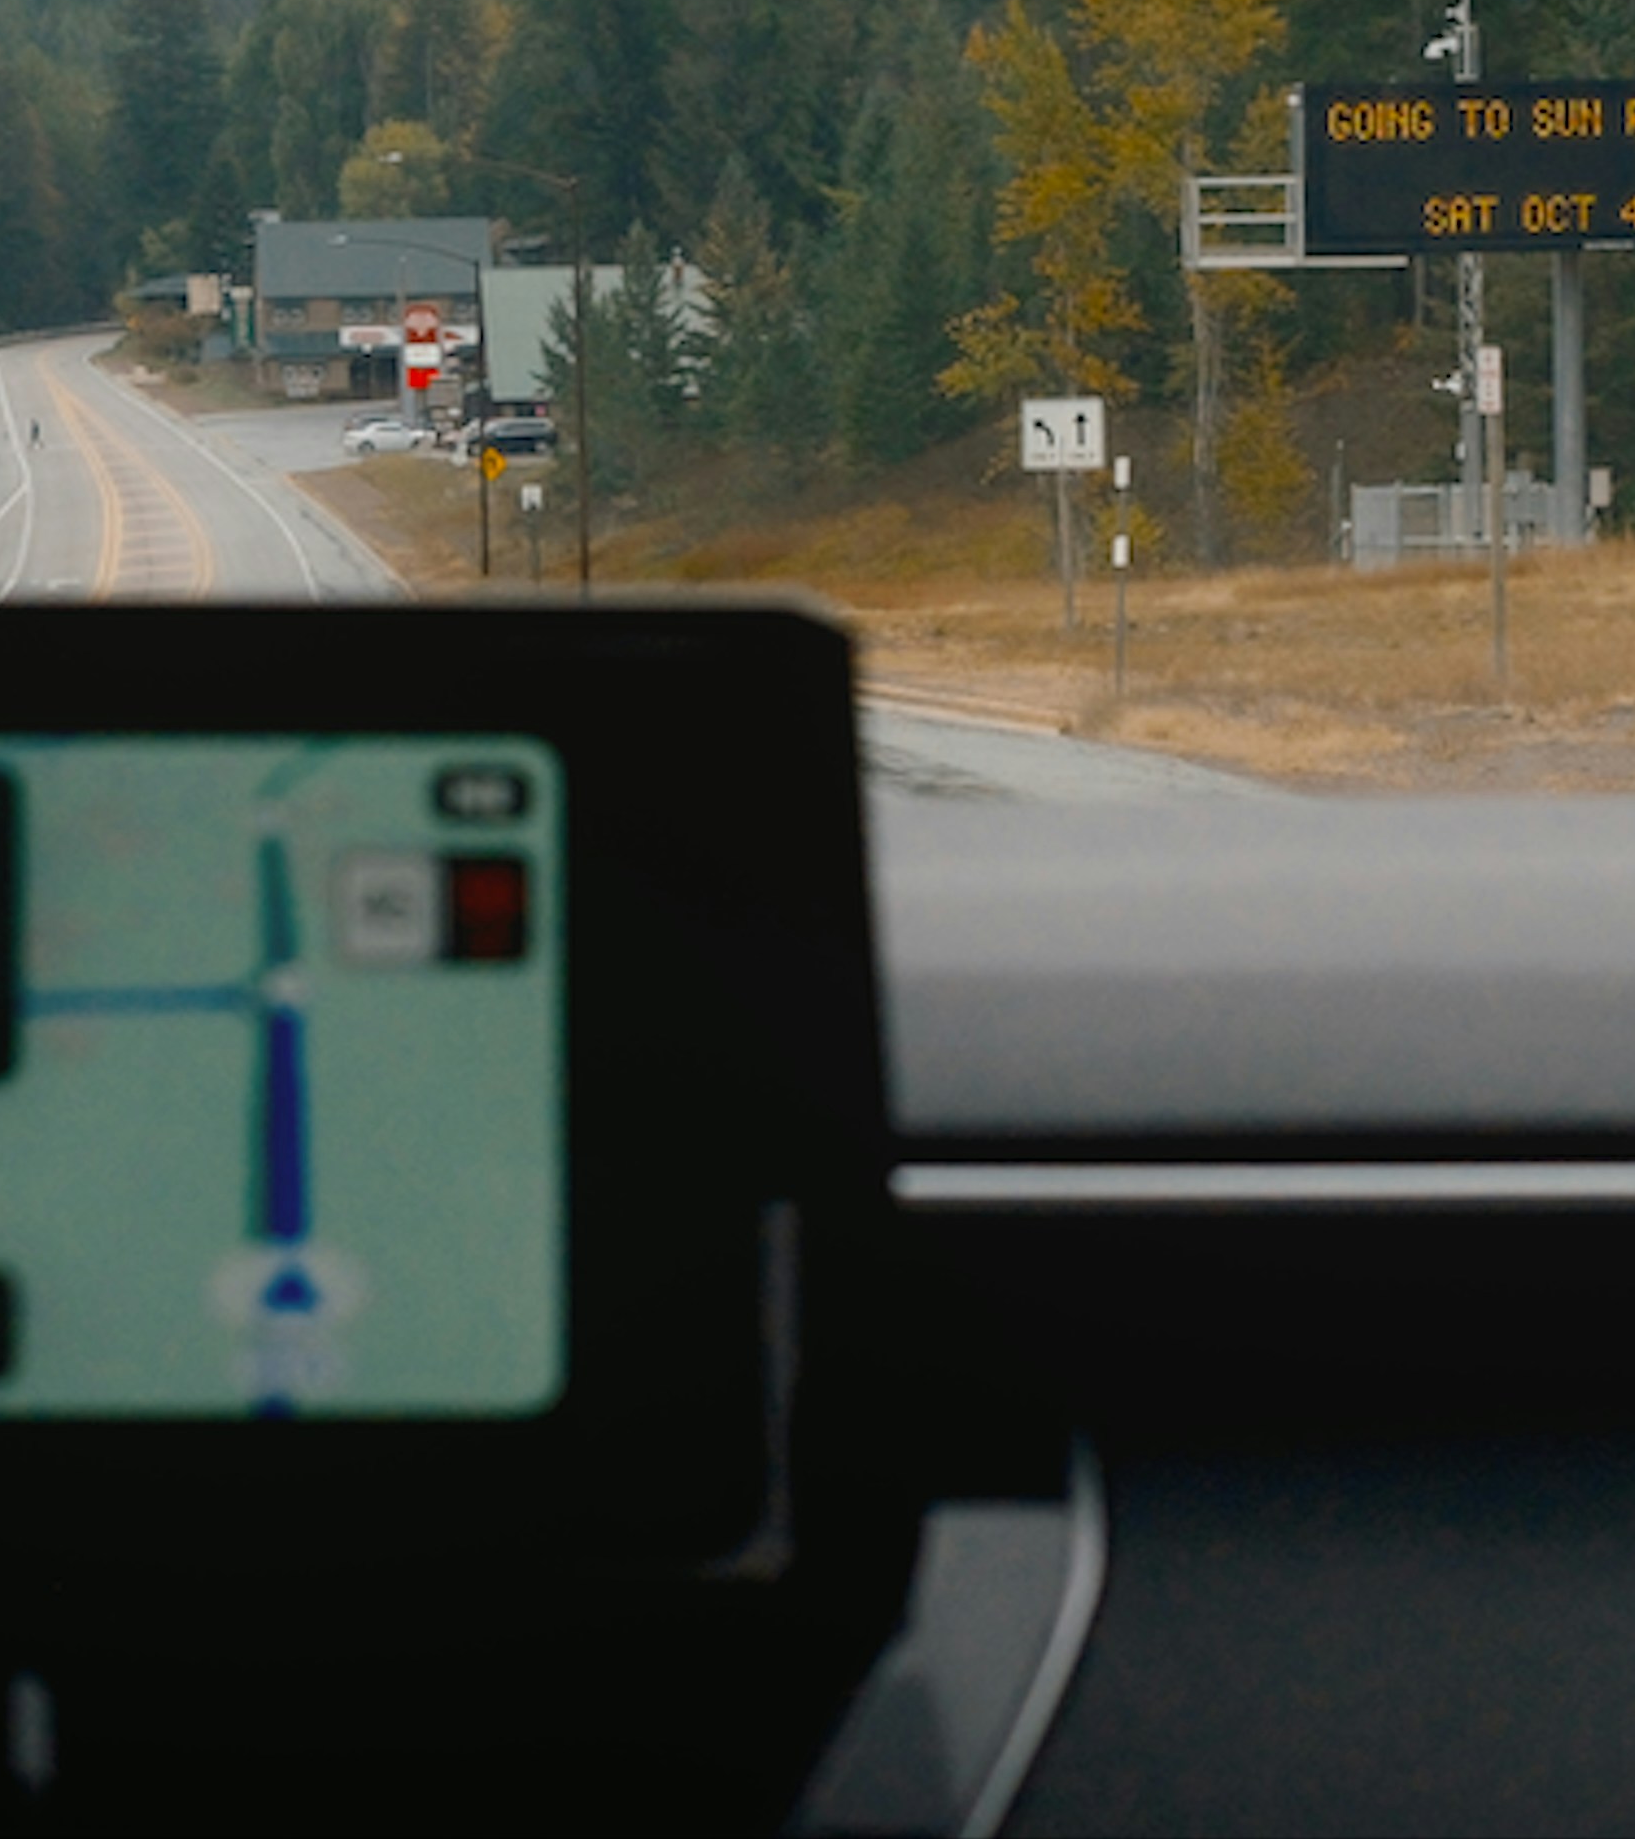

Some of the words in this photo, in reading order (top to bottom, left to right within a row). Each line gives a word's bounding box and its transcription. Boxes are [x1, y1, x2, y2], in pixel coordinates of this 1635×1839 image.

[1327, 100, 1435, 141] GOING
[1457, 98, 1512, 139] TO
[1532, 98, 1604, 138] SUN
[1423, 194, 1500, 235] SAT
[1521, 193, 1597, 233] OCT
